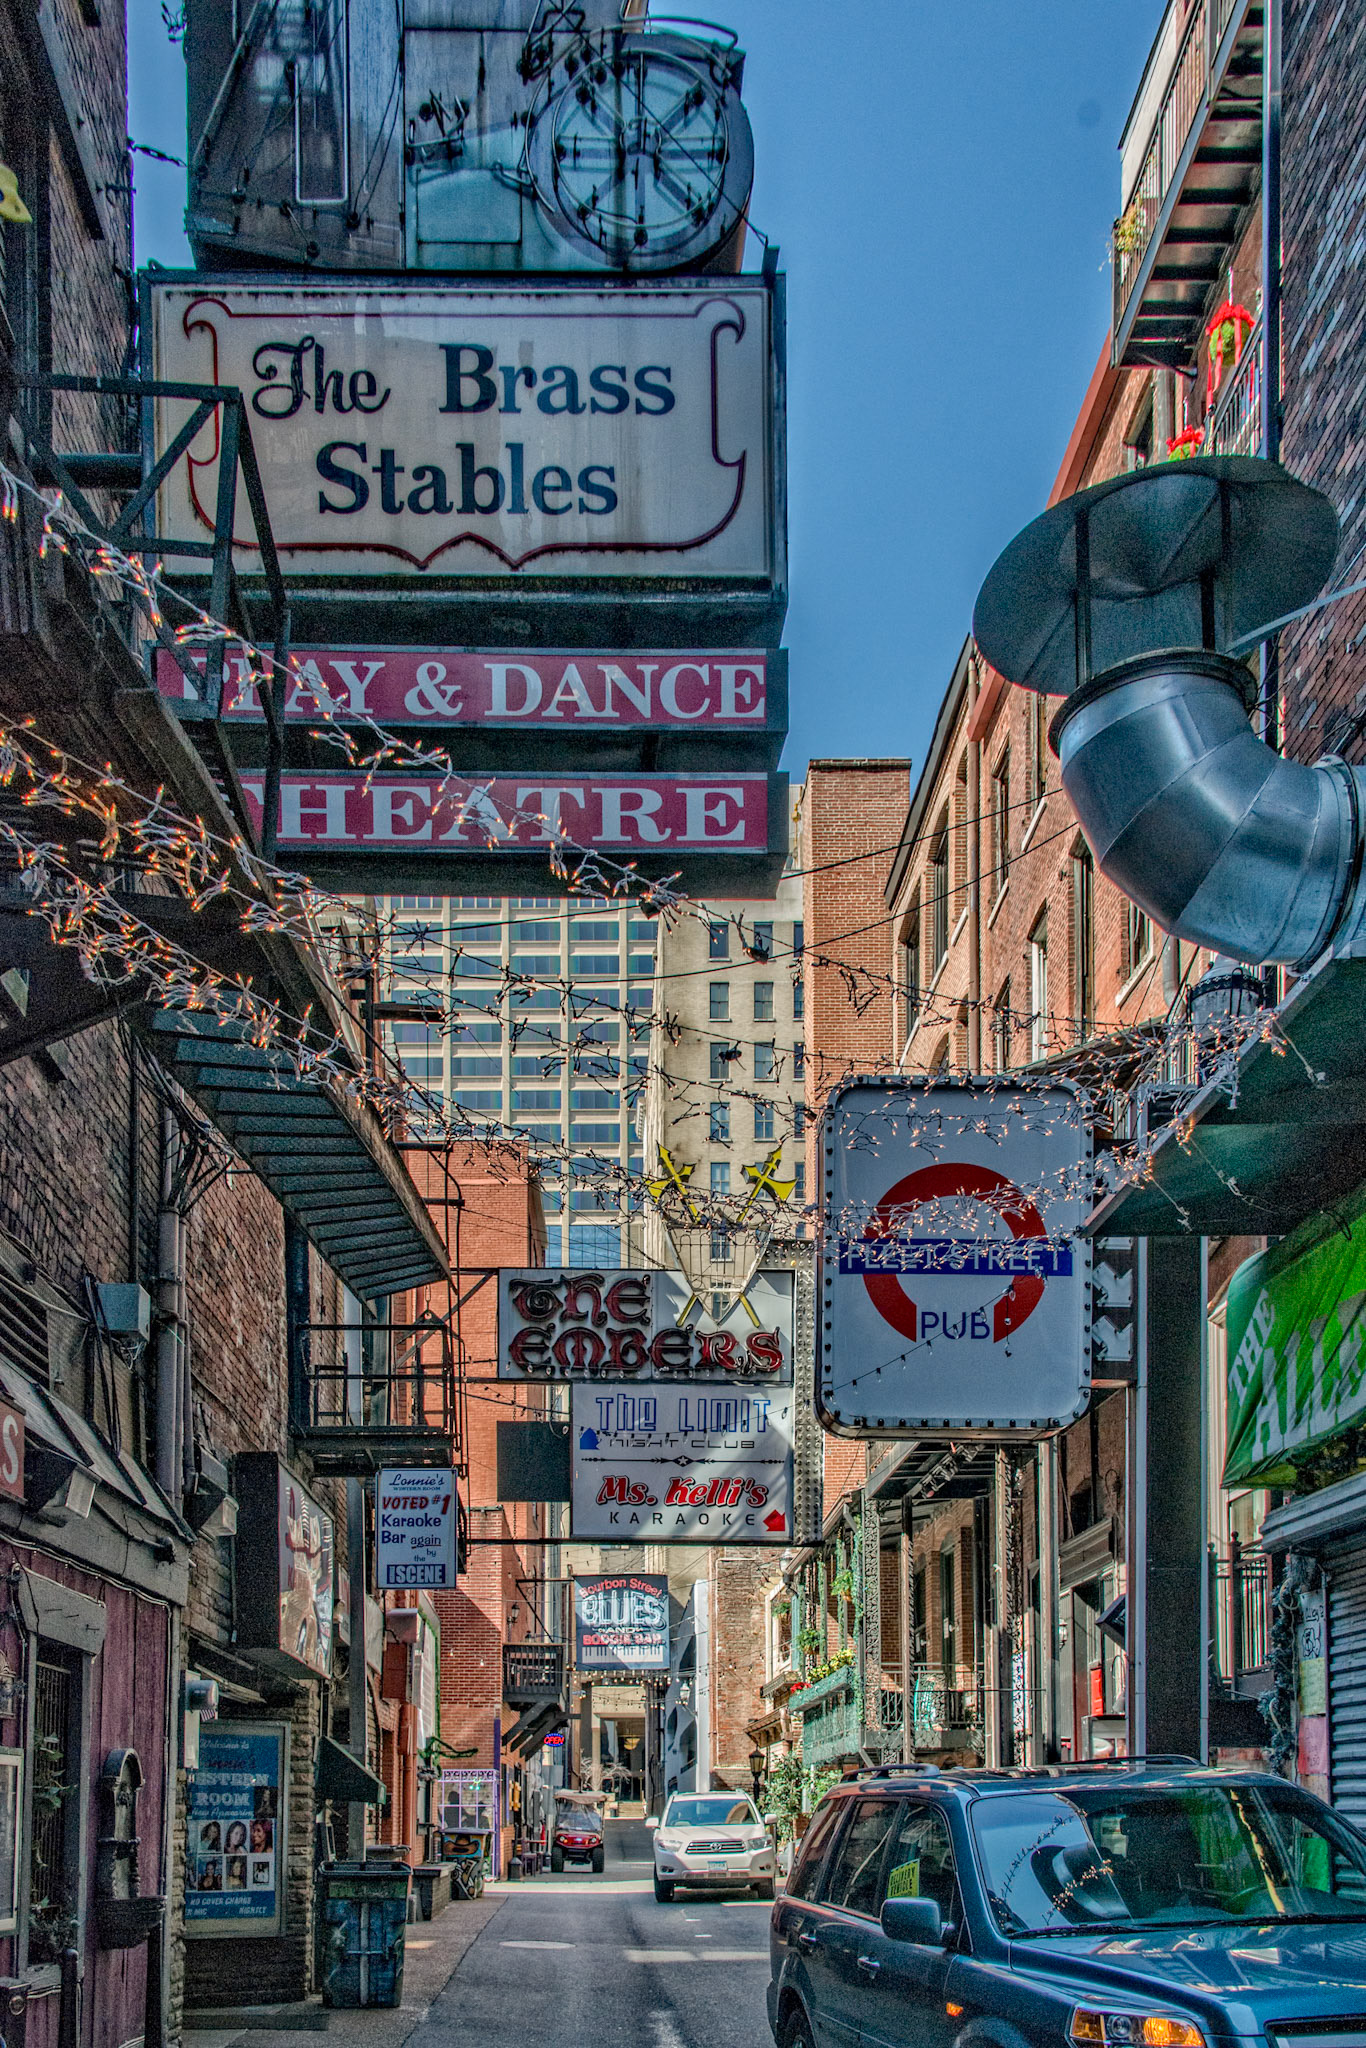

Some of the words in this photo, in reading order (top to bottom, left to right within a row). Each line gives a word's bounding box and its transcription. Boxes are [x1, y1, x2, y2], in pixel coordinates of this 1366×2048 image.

[252, 335, 391, 419] The
[438, 343, 676, 415] Brass
[316, 442, 618, 516] Stables
[404, 661, 464, 716] &
[484, 664, 765, 718] DANCE
[950, 1244, 1065, 1271] STREET
[509, 1273, 651, 1327] THE
[921, 1312, 990, 1340] PUB
[509, 1323, 784, 1375] EMBERS
[1228, 1288, 1276, 1408] THE
[679, 1398, 771, 1433] LIMIT
[691, 1440, 755, 1449] CLUB
[389, 1473, 445, 1486] Lonnie's
[597, 1475, 658, 1507] Ms.
[664, 1476, 769, 1508] Kelli's
[382, 1496, 429, 1510] VOTED
[432, 1494, 451, 1515] #1
[382, 1512, 441, 1527] Karaoke
[610, 1512, 755, 1525] KARAOKE
[382, 1531, 406, 1544] Bar
[410, 1534, 441, 1547] again
[427, 1548, 437, 1557] by
[579, 1578, 627, 1598] Bourbon
[629, 1578, 663, 1598] Street
[582, 1590, 662, 1627] BLUES
[583, 1634, 631, 1645] BOOGIE
[544, 1736, 565, 1744] OPEN
[195, 1773, 269, 1786] ESTERN
[195, 1793, 250, 1806] ROOM
